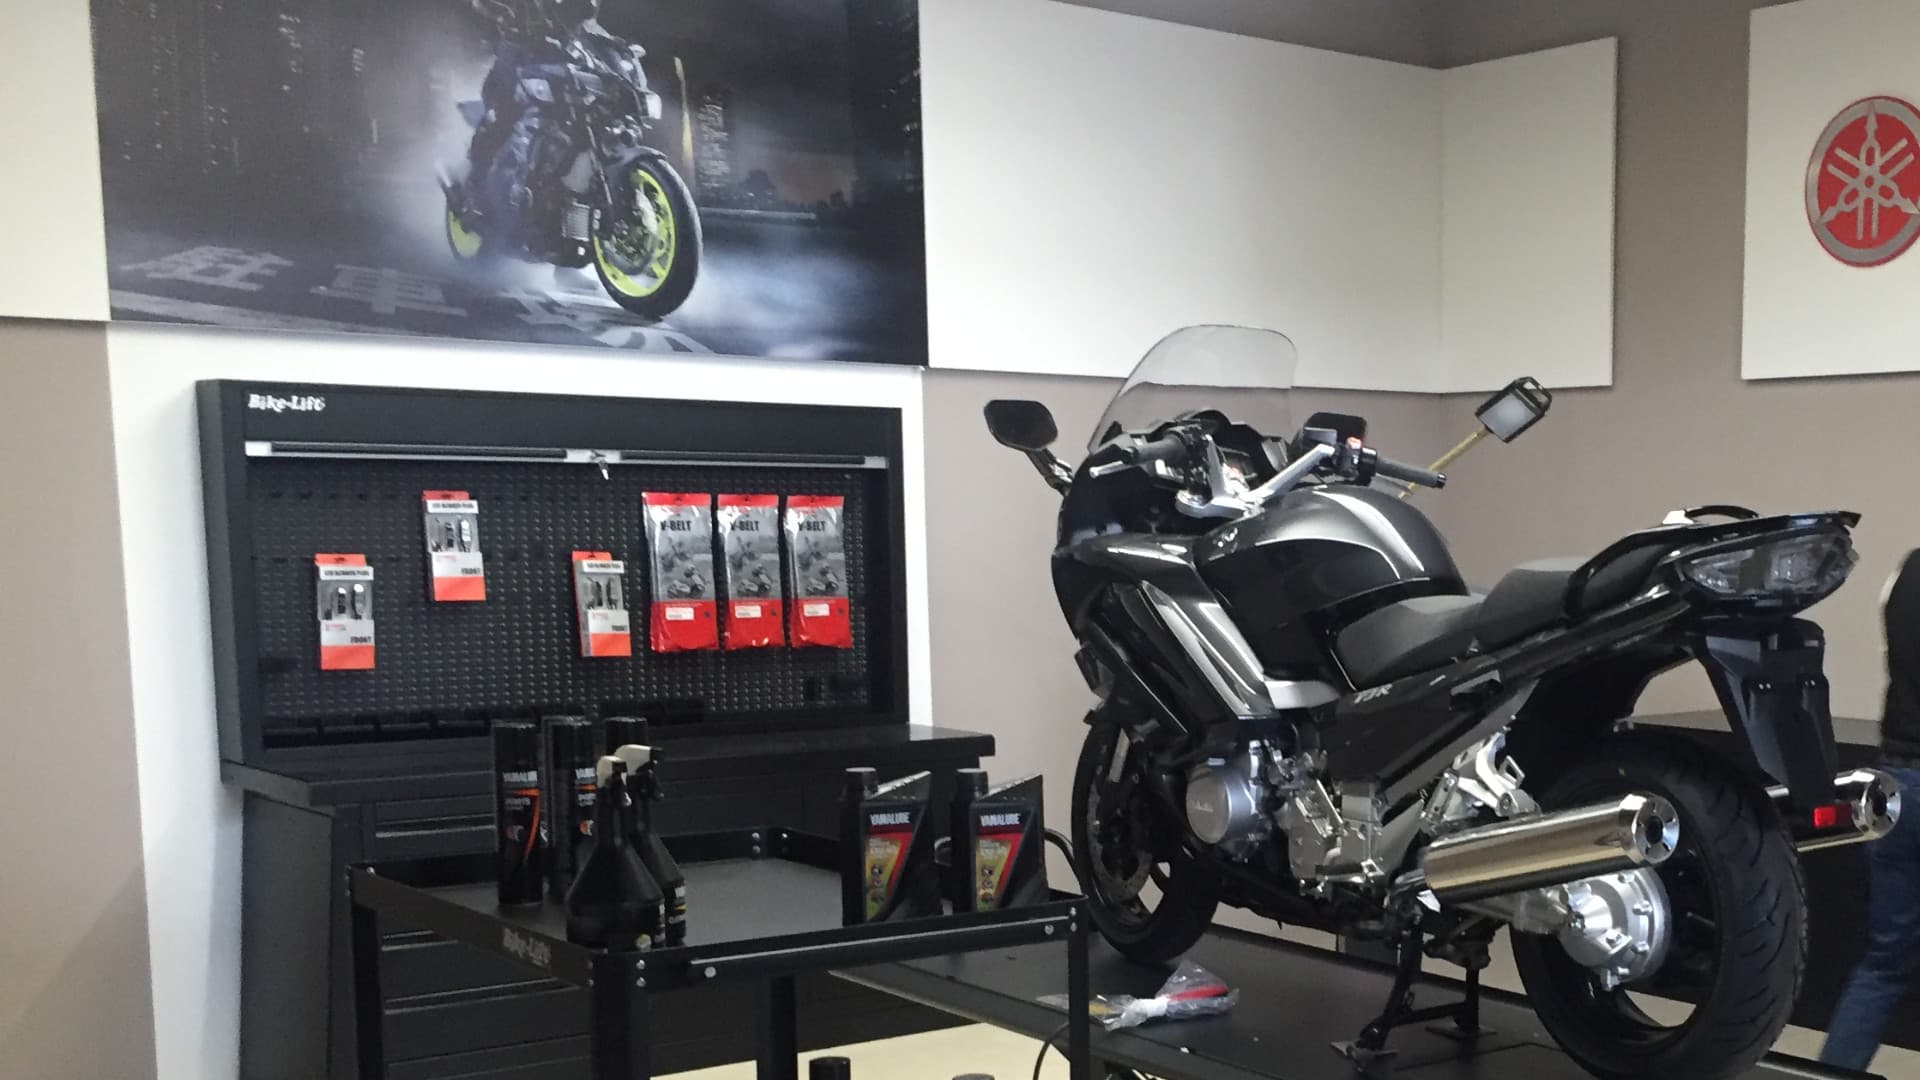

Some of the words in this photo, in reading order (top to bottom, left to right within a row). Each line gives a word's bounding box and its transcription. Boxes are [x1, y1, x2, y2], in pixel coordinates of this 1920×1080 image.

[247, 393, 326, 413] Bike-Lift
[660, 519, 692, 532] V-BELT
[980, 813, 1021, 827] YAMALUBE
